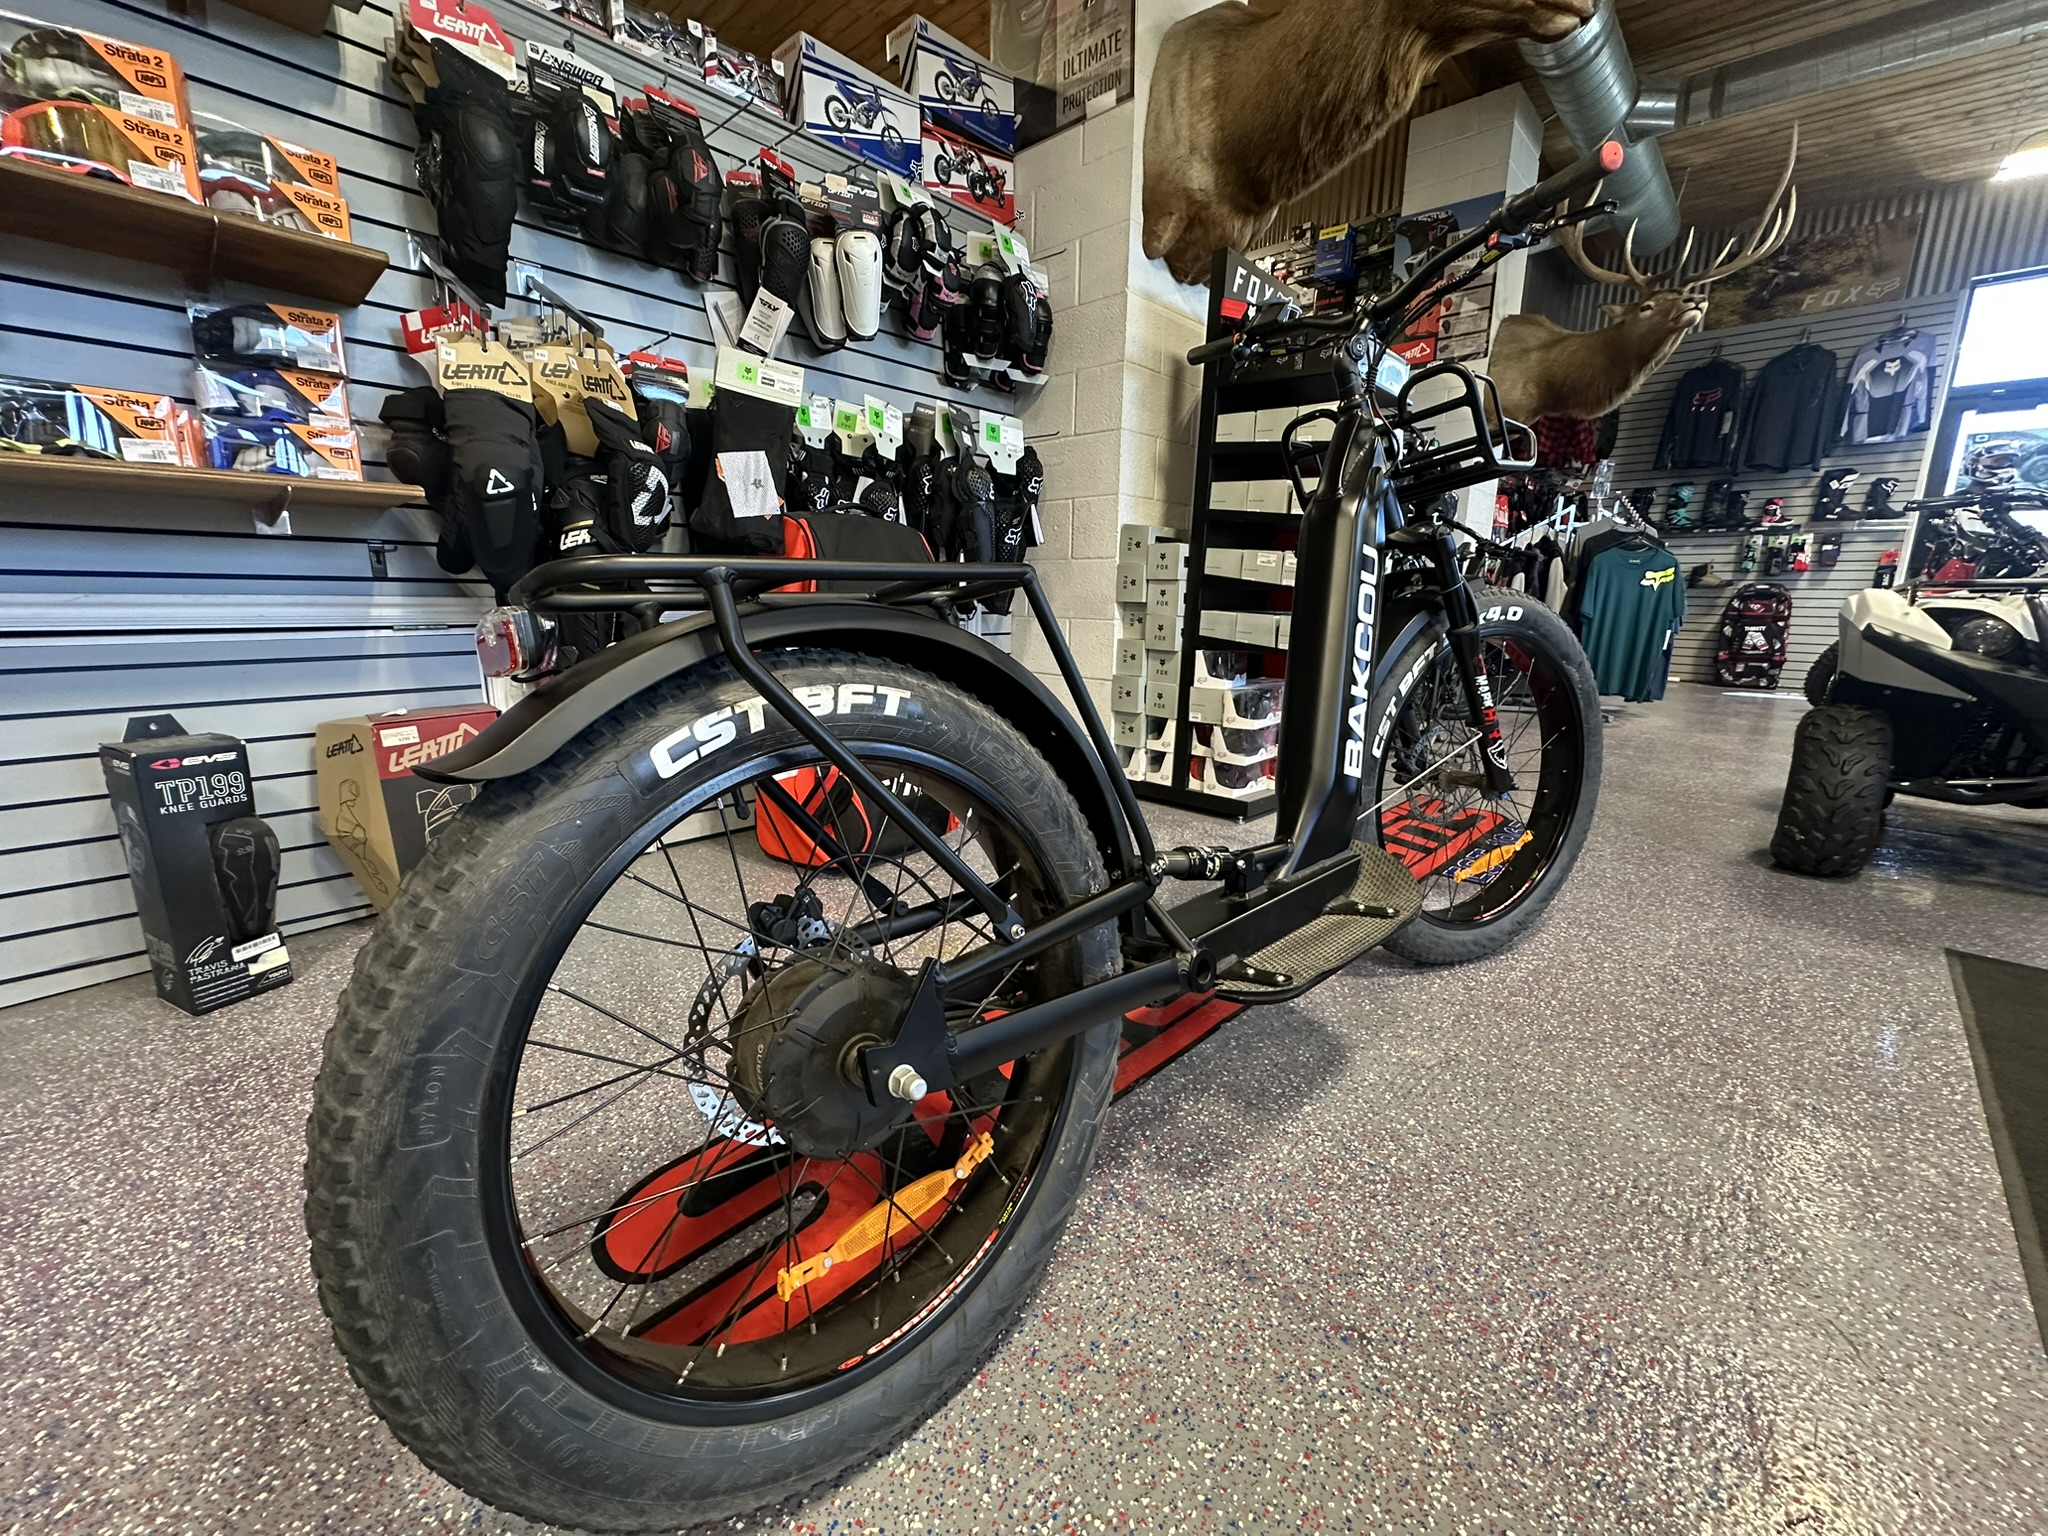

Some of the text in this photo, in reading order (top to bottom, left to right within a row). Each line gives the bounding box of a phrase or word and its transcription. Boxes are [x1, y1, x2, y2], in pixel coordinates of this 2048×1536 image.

[104, 43, 164, 68] Strata 2
[1063, 28, 1122, 81] ULTIMATE
[1062, 68, 1122, 115] PROTECTION
[123, 118, 184, 146] Strata 2
[323, 158, 331, 168] 2
[293, 191, 341, 212] Strata 2
[801, 197, 828, 209] OPTION
[827, 187, 854, 199] OPTION
[1801, 285, 1864, 311] FOX
[288, 312, 333, 327] Strata 2
[296, 377, 330, 390] Strata
[442, 363, 510, 383] LEATT
[581, 373, 614, 396] LEATT
[103, 394, 151, 410] Strata
[559, 528, 593, 551] LEA
[1343, 543, 1379, 779] BAKCOU
[1371, 695, 1397, 758] CST
[1398, 640, 1438, 698] BFT
[648, 682, 913, 780] CST BFT
[326, 735, 357, 759] LEATT
[389, 729, 466, 773] LEATT
[155, 771, 246, 806] TP199
[160, 793, 248, 815] KNEE GUARDS
[187, 960, 229, 976] TRAVIS
[190, 962, 248, 984] PASTRANA
[417, 1066, 447, 1136] NYLON
